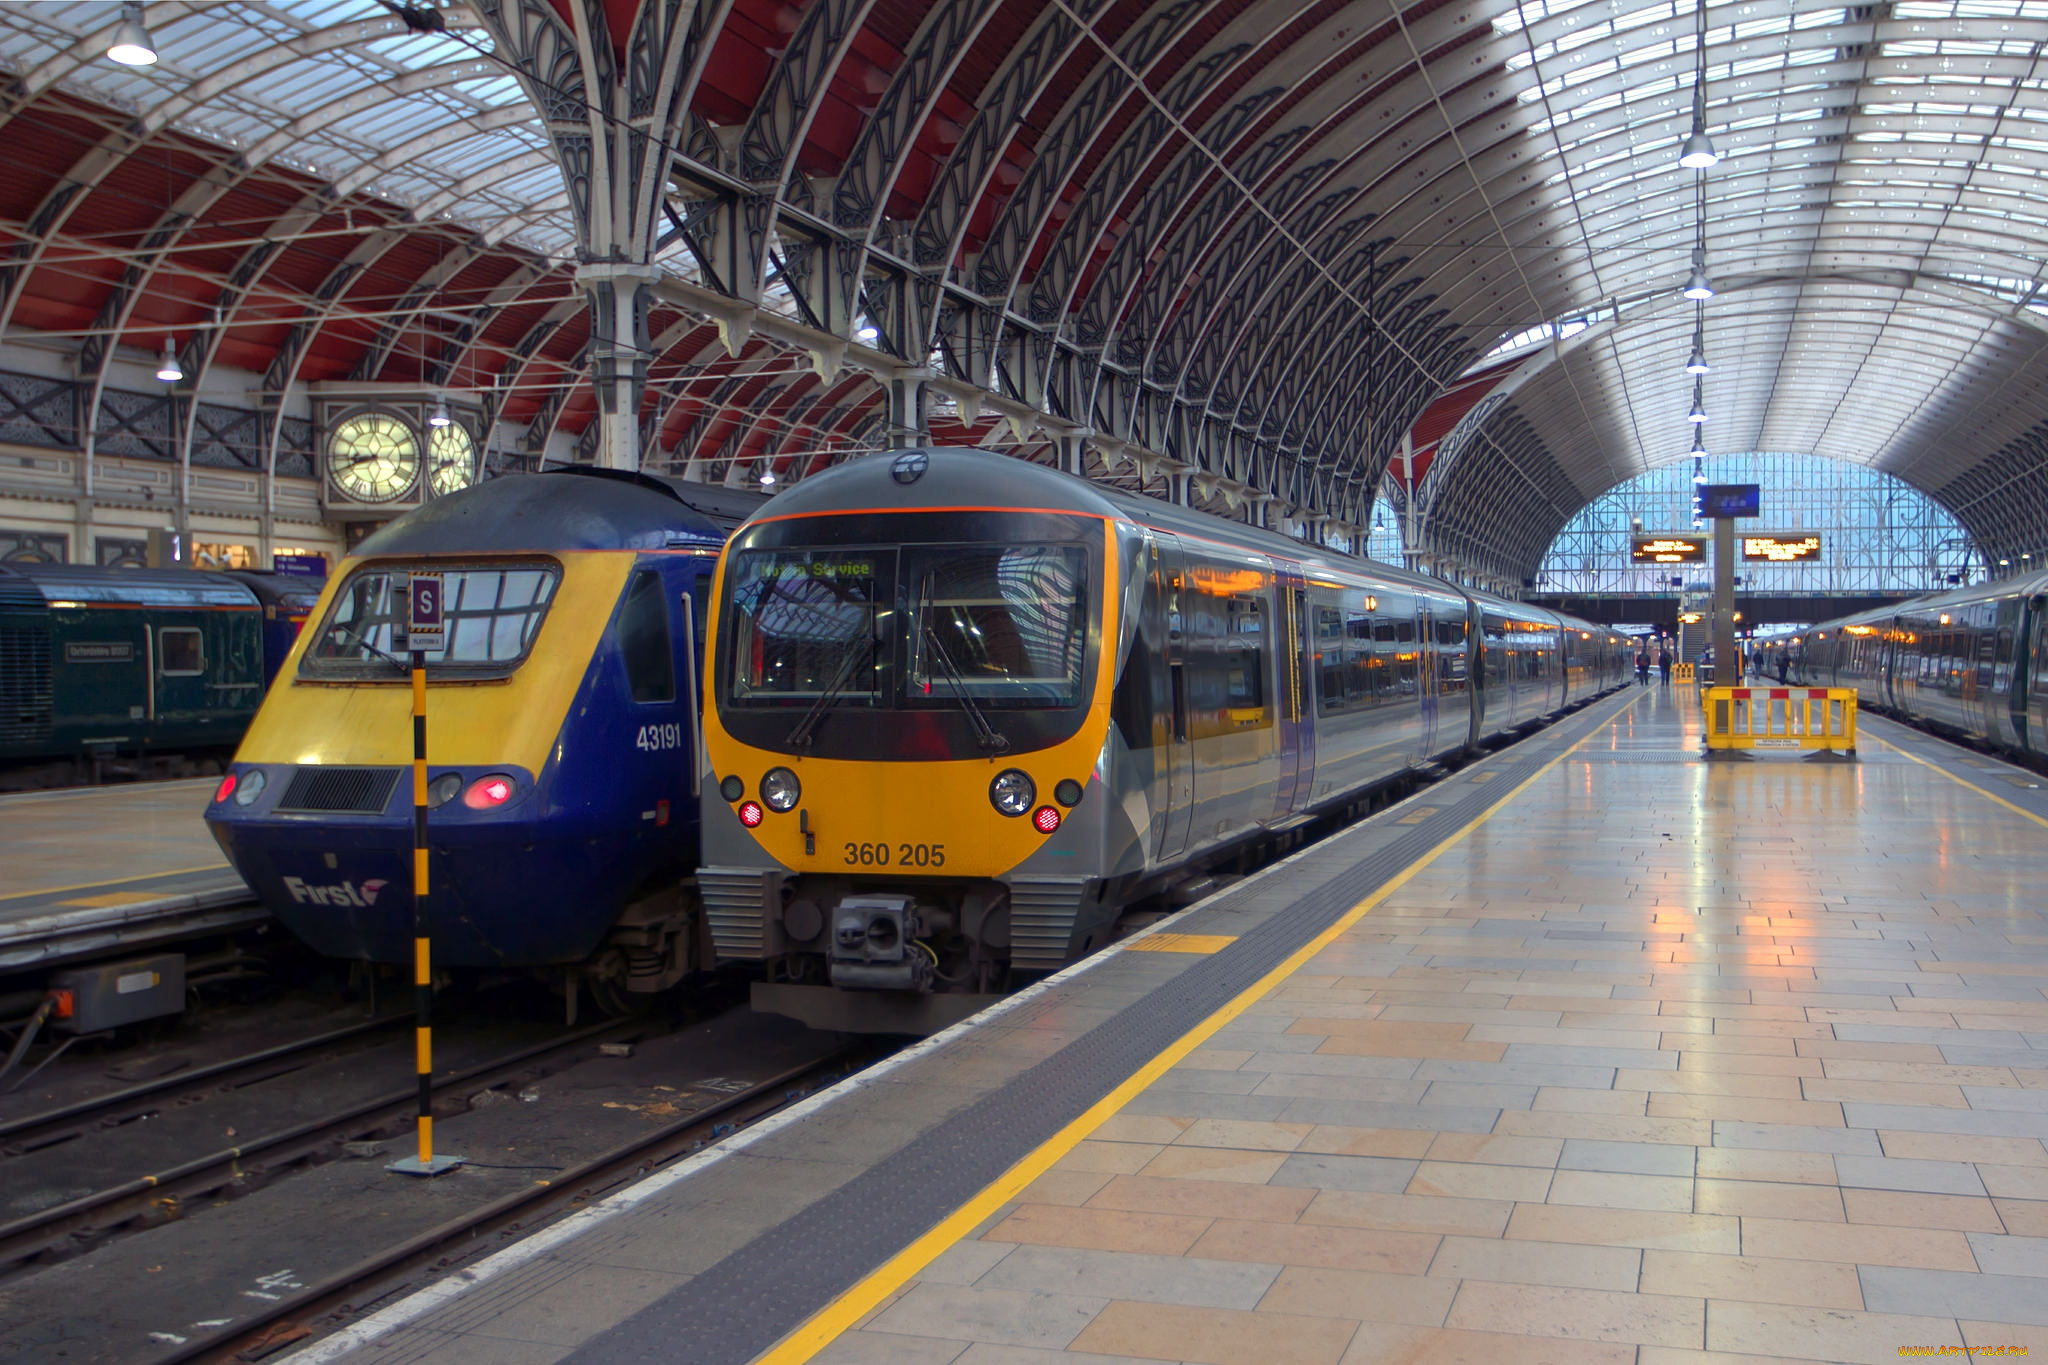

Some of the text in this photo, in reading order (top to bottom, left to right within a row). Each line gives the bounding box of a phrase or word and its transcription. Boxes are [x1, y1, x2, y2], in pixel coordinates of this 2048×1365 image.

[813, 561, 870, 577] Service
[420, 590, 433, 614] S
[636, 723, 681, 751] 43191
[844, 842, 946, 867] 360 205
[283, 876, 367, 907] First
